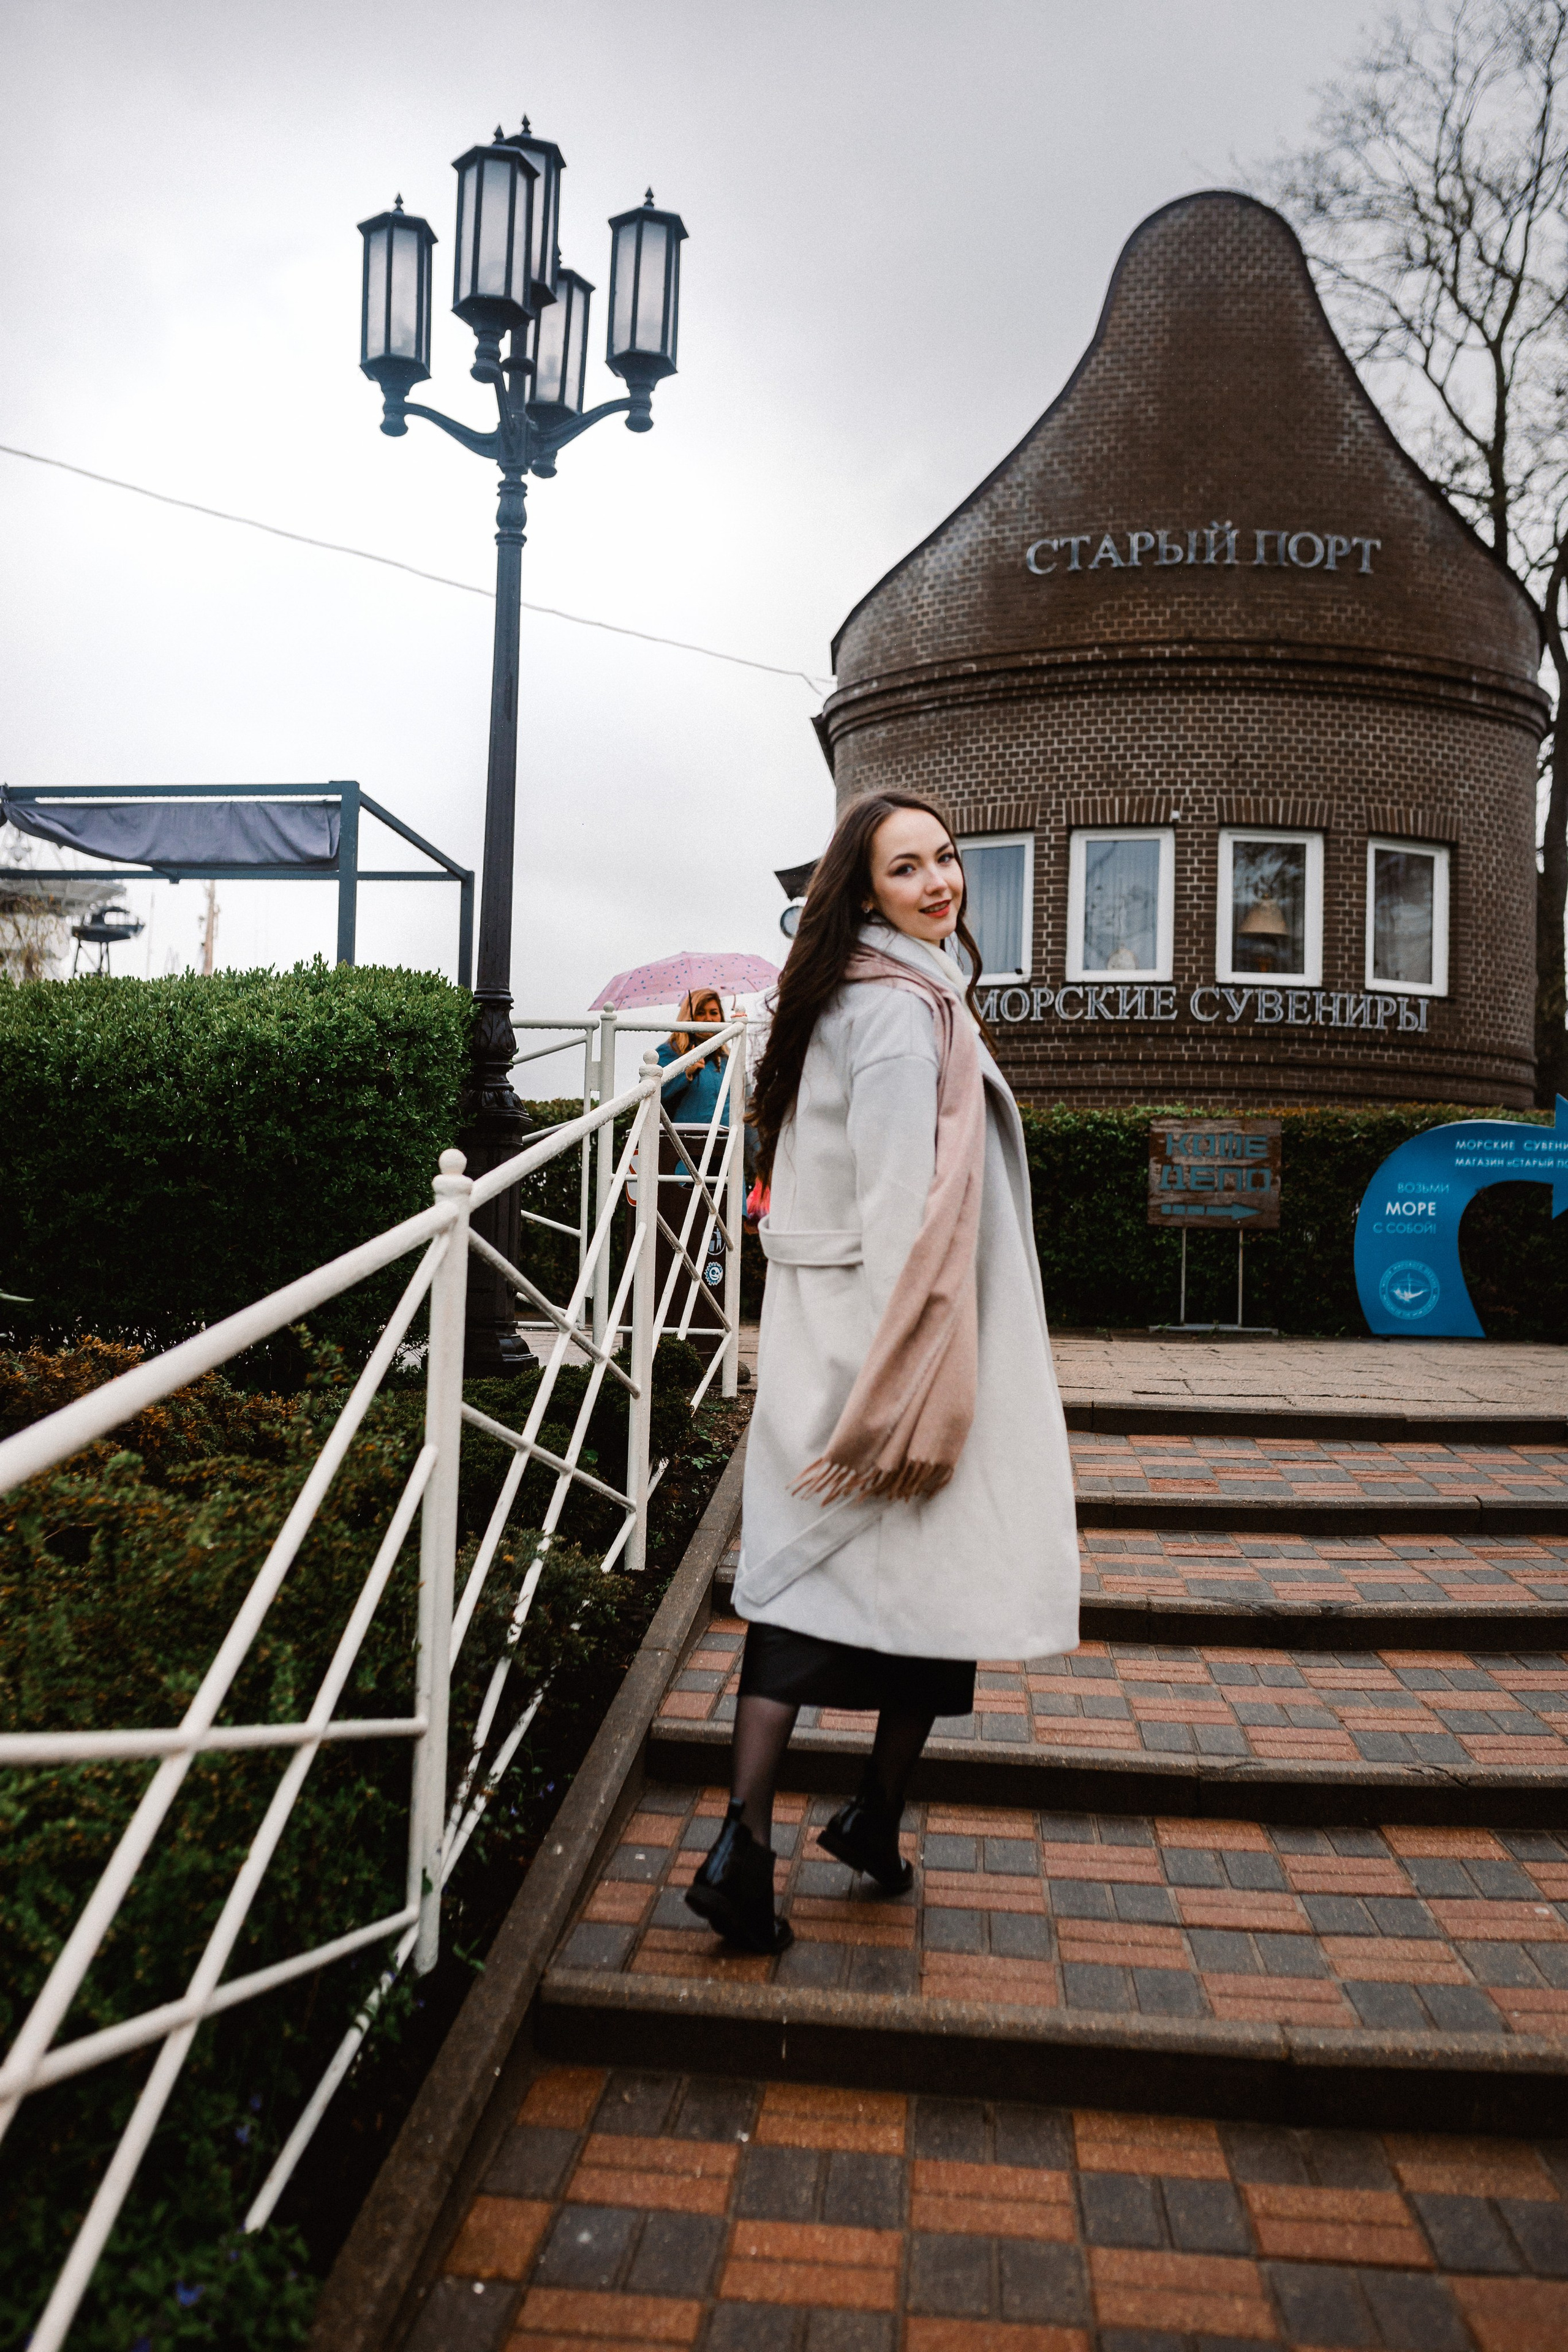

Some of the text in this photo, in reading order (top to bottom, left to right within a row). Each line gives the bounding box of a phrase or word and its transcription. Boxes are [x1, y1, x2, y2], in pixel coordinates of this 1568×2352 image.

[1025, 519, 1382, 575] СТАРЫЙ ПОРТ
[973, 986, 1430, 1033] МОРСКИЕ СУВЕНИРЫ
[1166, 1132, 1268, 1161] КОФЕ
[1455, 1139, 1515, 1151] МОРСКИЕ
[1455, 1157, 1504, 1167] МАГАЗИН
[1159, 1164, 1272, 1193] ДЕПО
[1397, 1182, 1450, 1194] ВОЗЬМИ
[1385, 1201, 1436, 1216] МОРЕ
[1373, 1222, 1382, 1234] С
